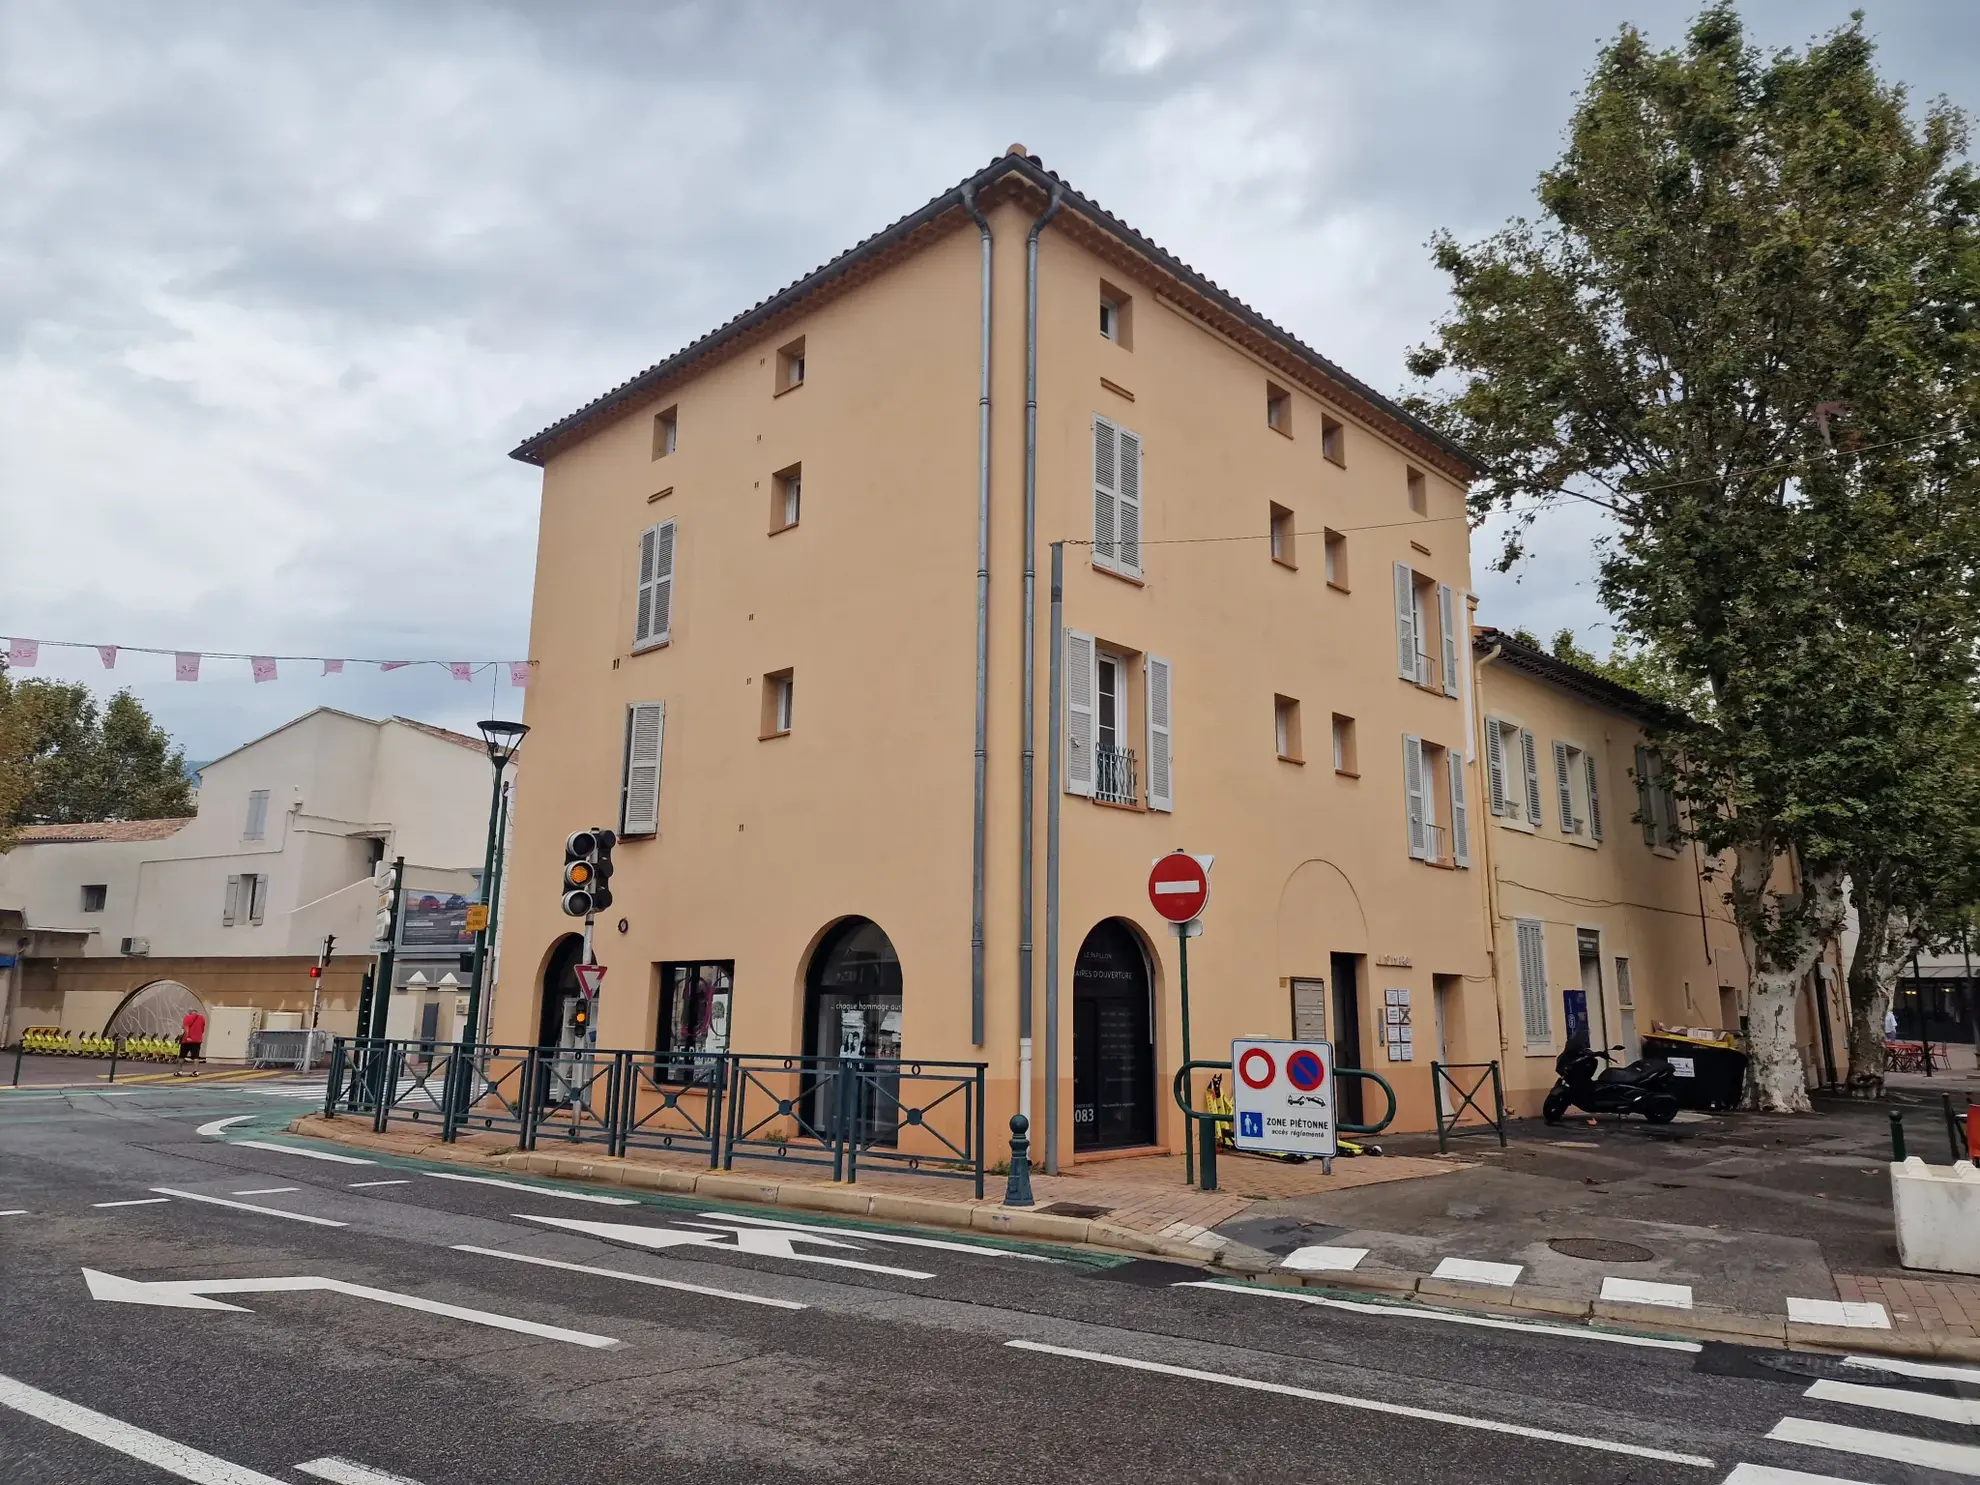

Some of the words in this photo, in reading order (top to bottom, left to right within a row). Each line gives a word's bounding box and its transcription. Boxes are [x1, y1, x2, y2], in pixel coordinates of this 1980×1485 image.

[836, 1000, 857, 1011] chaque
[858, 1000, 889, 1012] hommage
[1266, 1117, 1287, 1127] ZONE
[1290, 1118, 1328, 1130] PIÉTONNE
